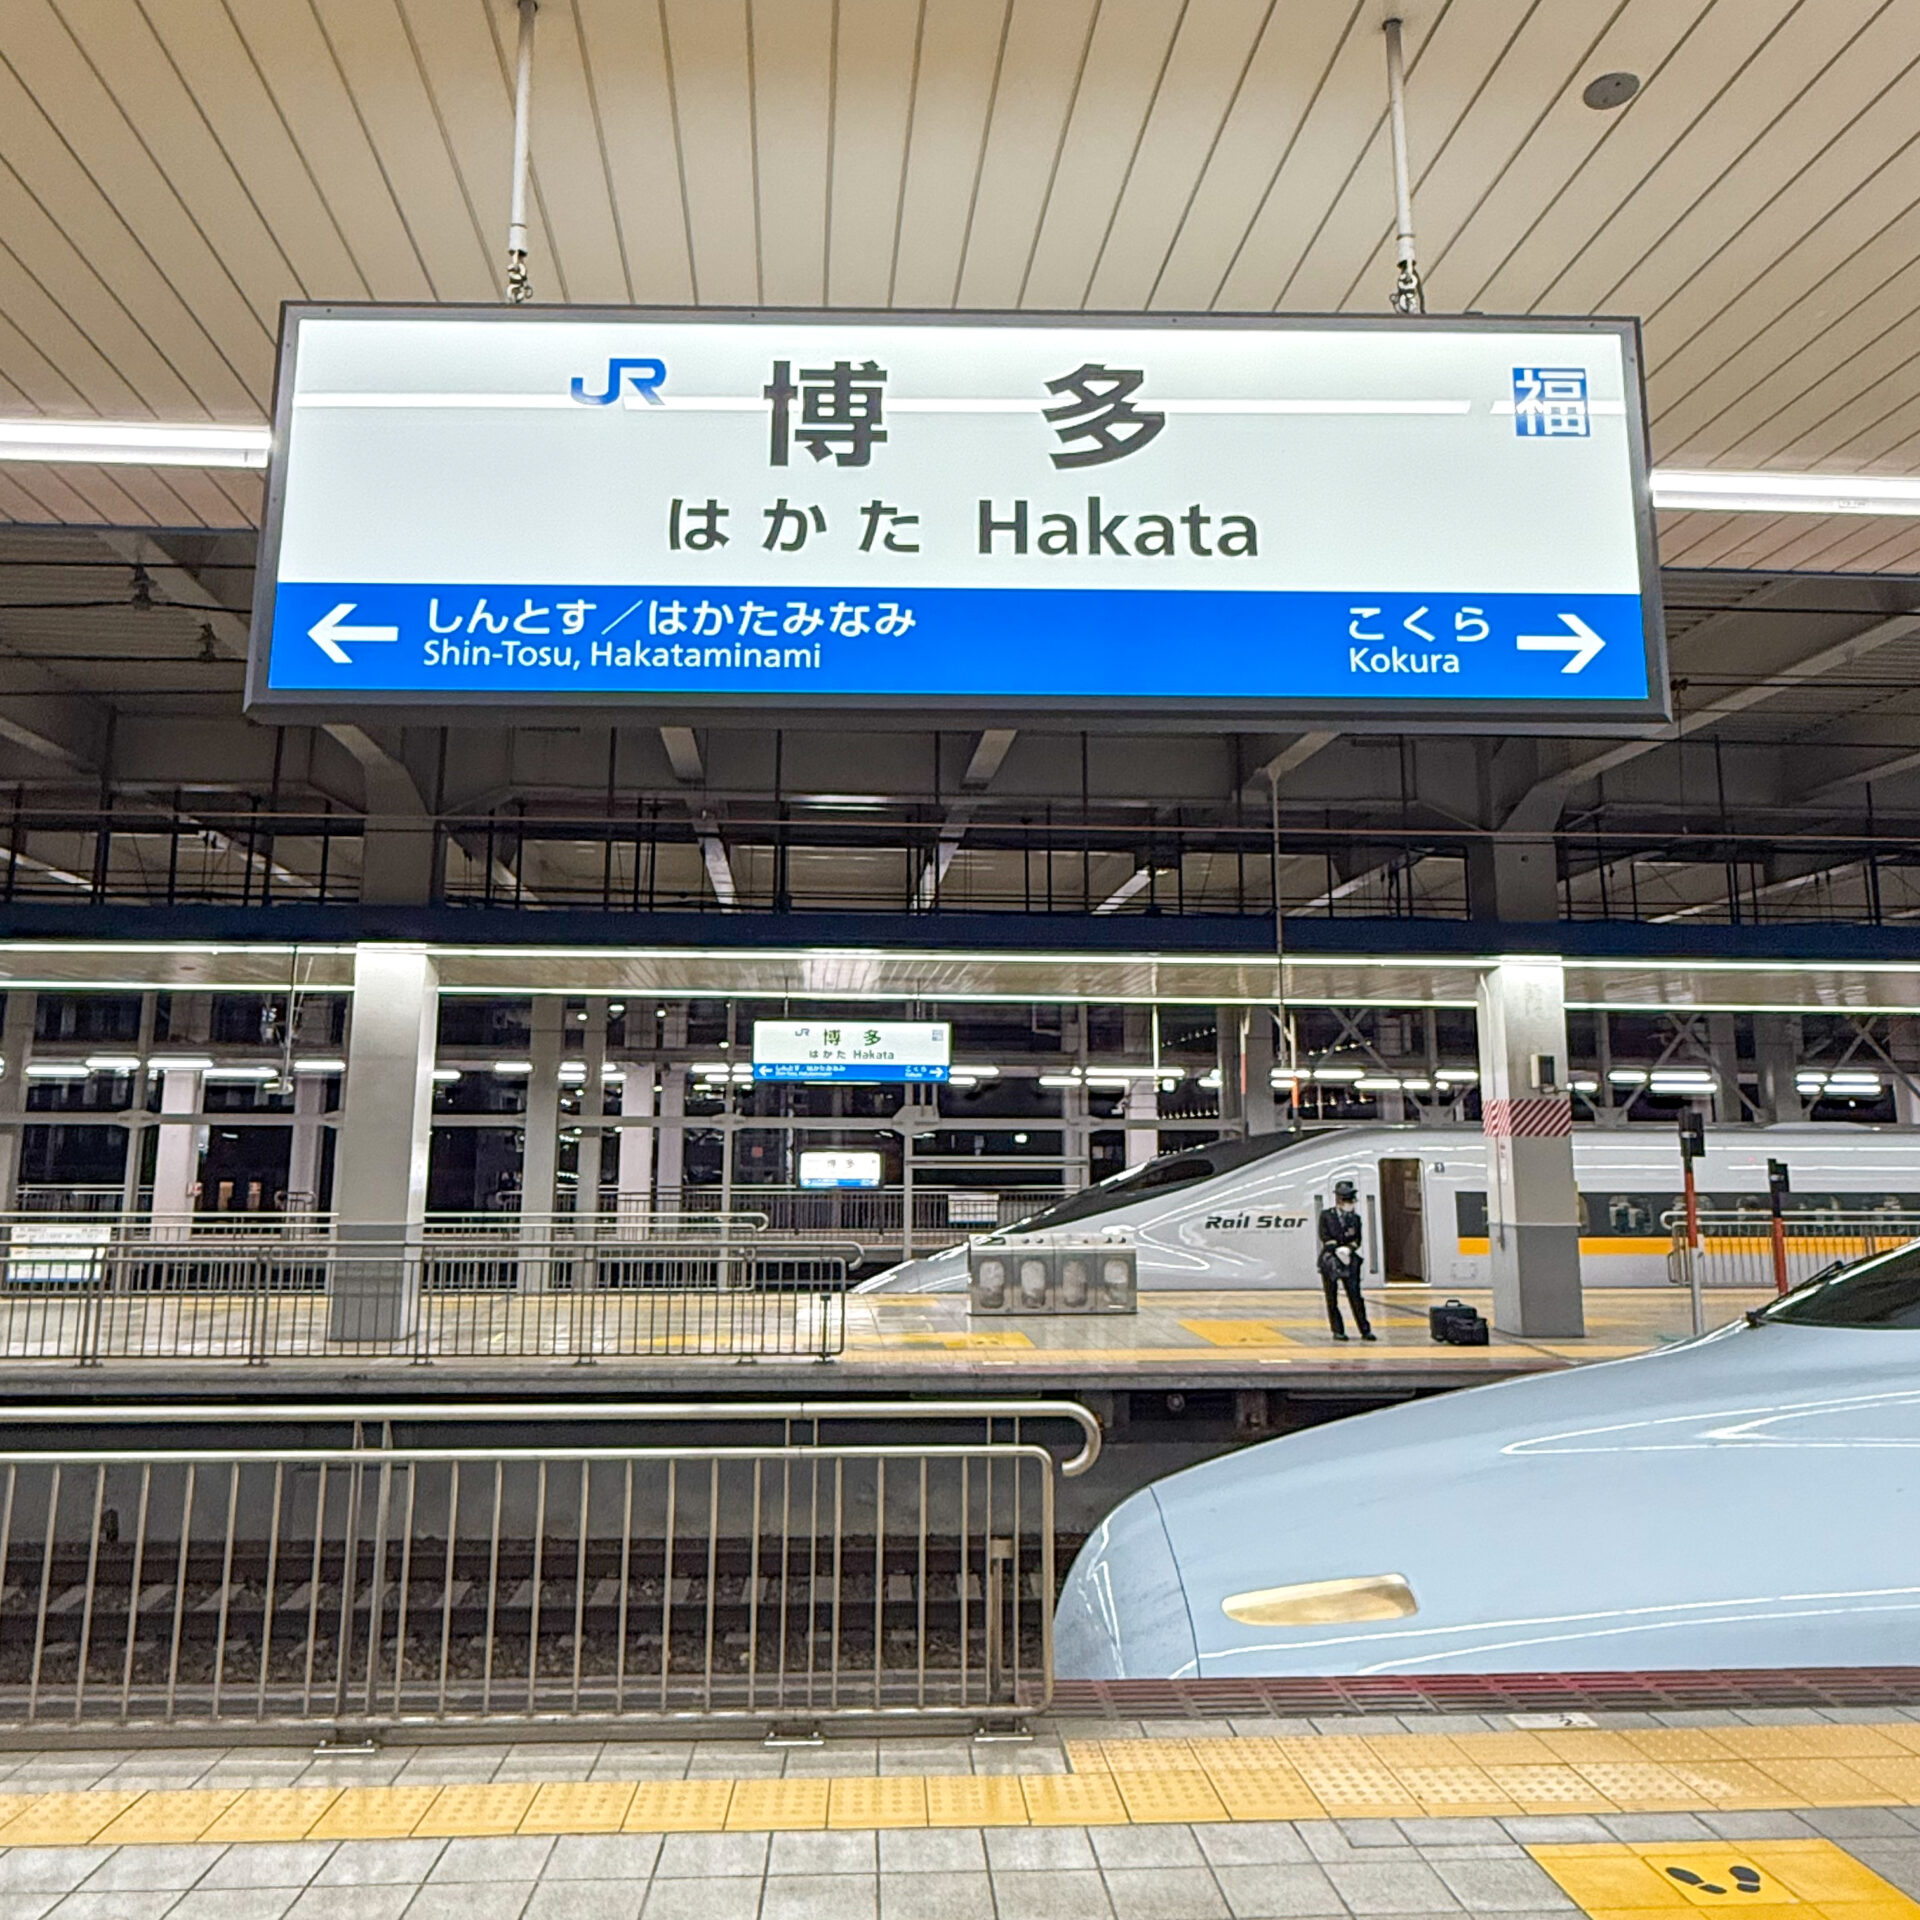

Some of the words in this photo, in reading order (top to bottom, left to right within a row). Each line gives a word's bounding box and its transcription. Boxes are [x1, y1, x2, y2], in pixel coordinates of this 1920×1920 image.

[570, 358, 667, 405] JR
[763, 360, 1166, 469] 博多
[1514, 369, 1588, 437] 福
[669, 498, 920, 553] はかた
[979, 496, 1258, 557] Hakata
[1348, 605, 1490, 642] こくら
[424, 639, 581, 670] Shin-Tosu,
[591, 641, 821, 668] Hakataminami
[1350, 646, 1460, 673] Kokura
[795, 1028, 810, 1037] JR
[823, 1028, 882, 1046] 博多
[853, 1050, 895, 1059] Hakata
[1205, 1212, 1250, 1229] Rail
[1256, 1215, 1308, 1229] Star
